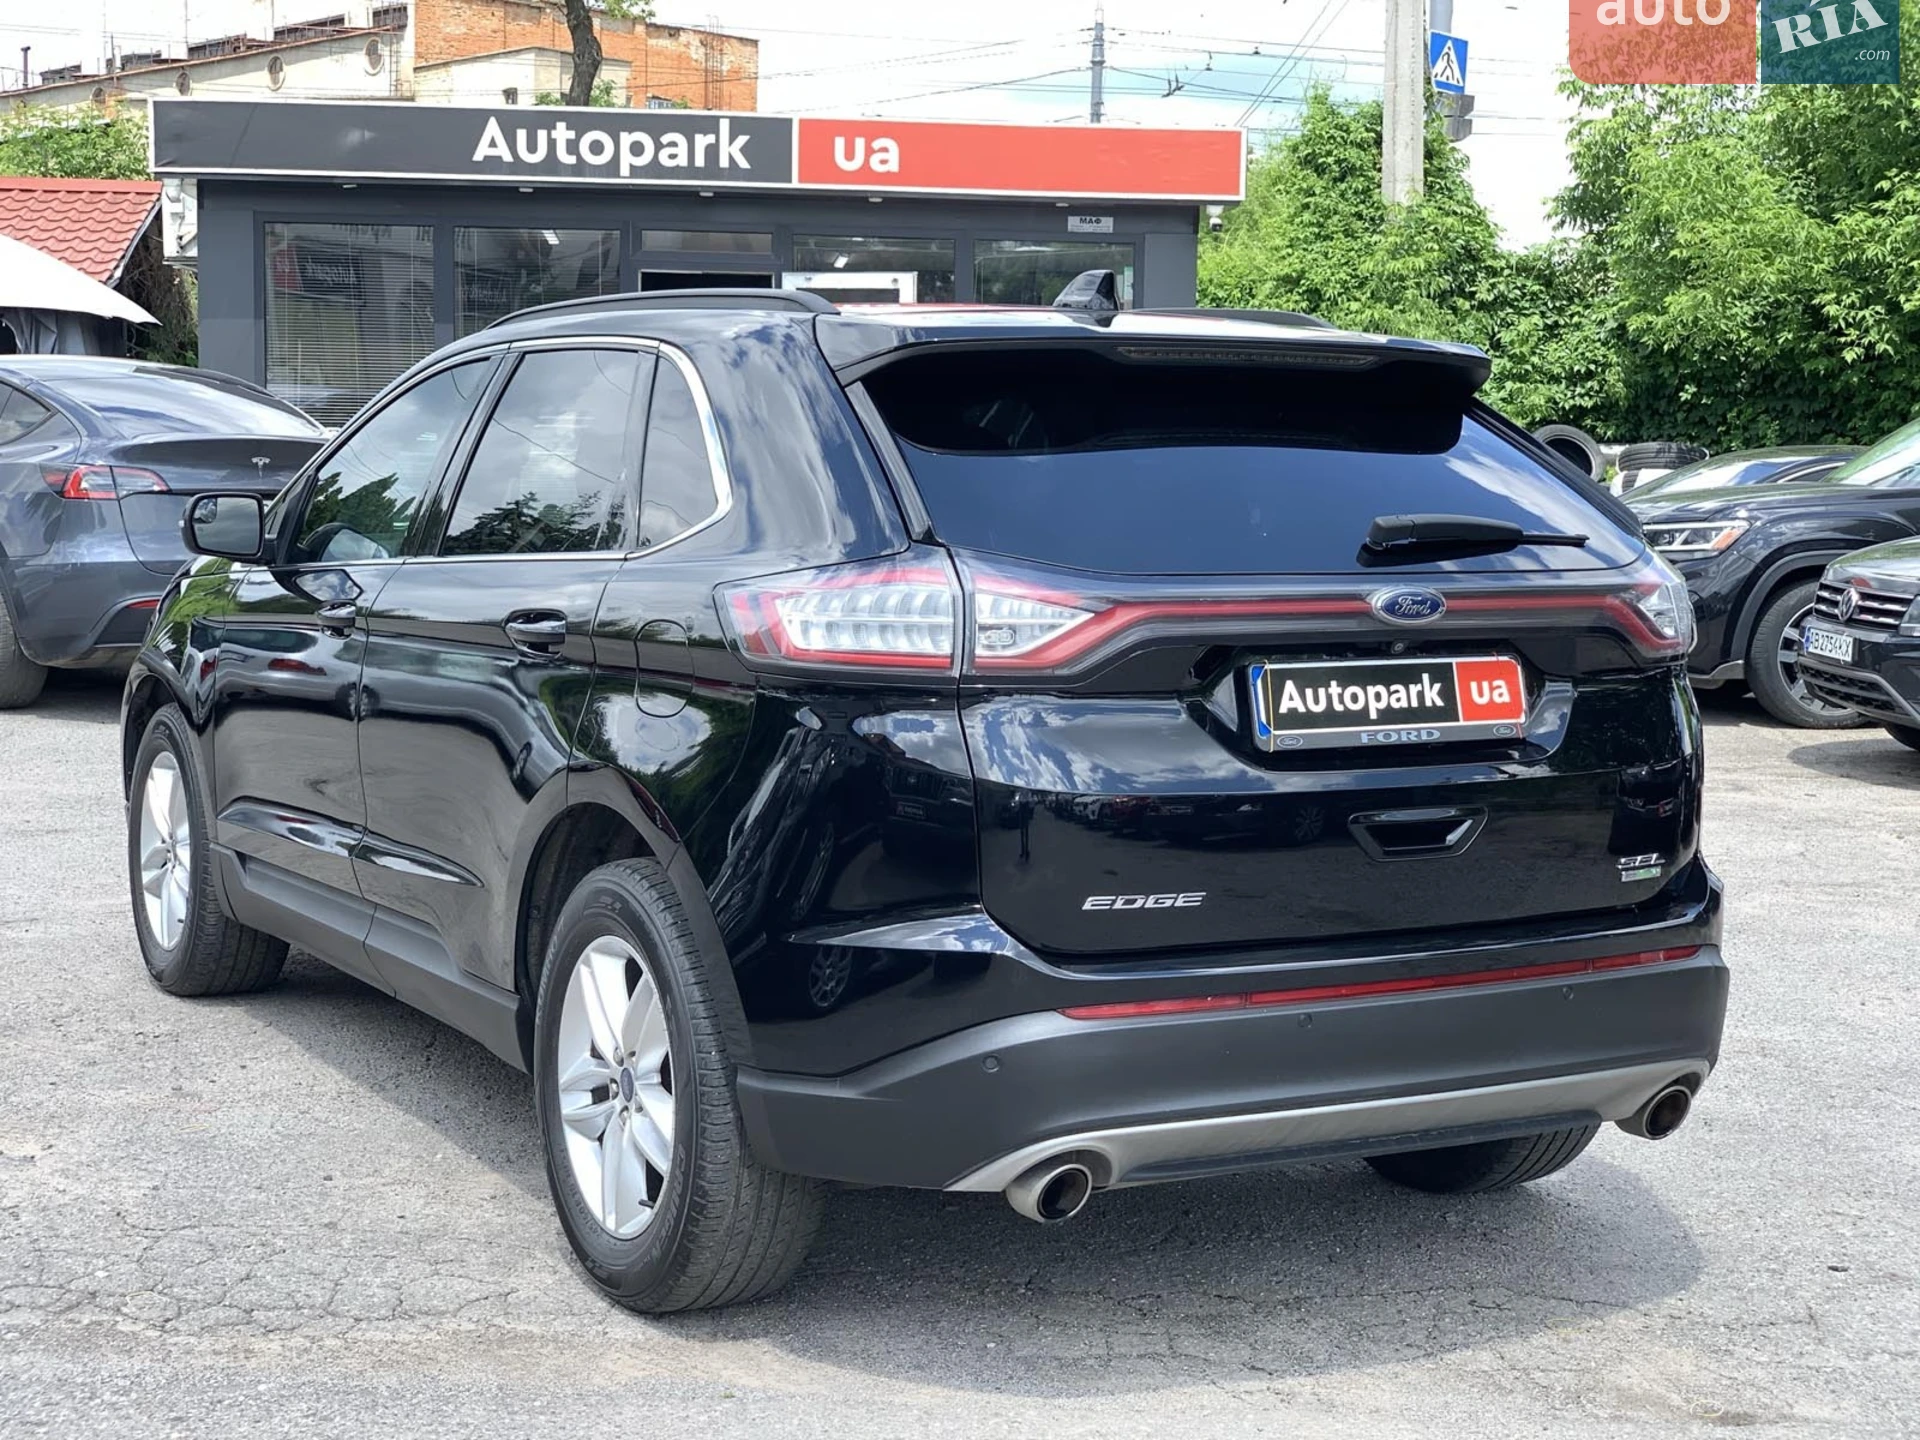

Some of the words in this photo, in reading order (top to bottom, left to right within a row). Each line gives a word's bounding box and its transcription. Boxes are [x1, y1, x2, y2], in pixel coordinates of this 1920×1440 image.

[472, 116, 751, 176] Autopark
[833, 135, 899, 173] ua
[1395, 595, 1431, 615] Ford
[1278, 673, 1445, 719] Autopark
[1470, 679, 1511, 705] ua
[1360, 729, 1441, 743] FORD
[1615, 852, 1666, 869] SEL
[1081, 892, 1207, 910] EDGE
